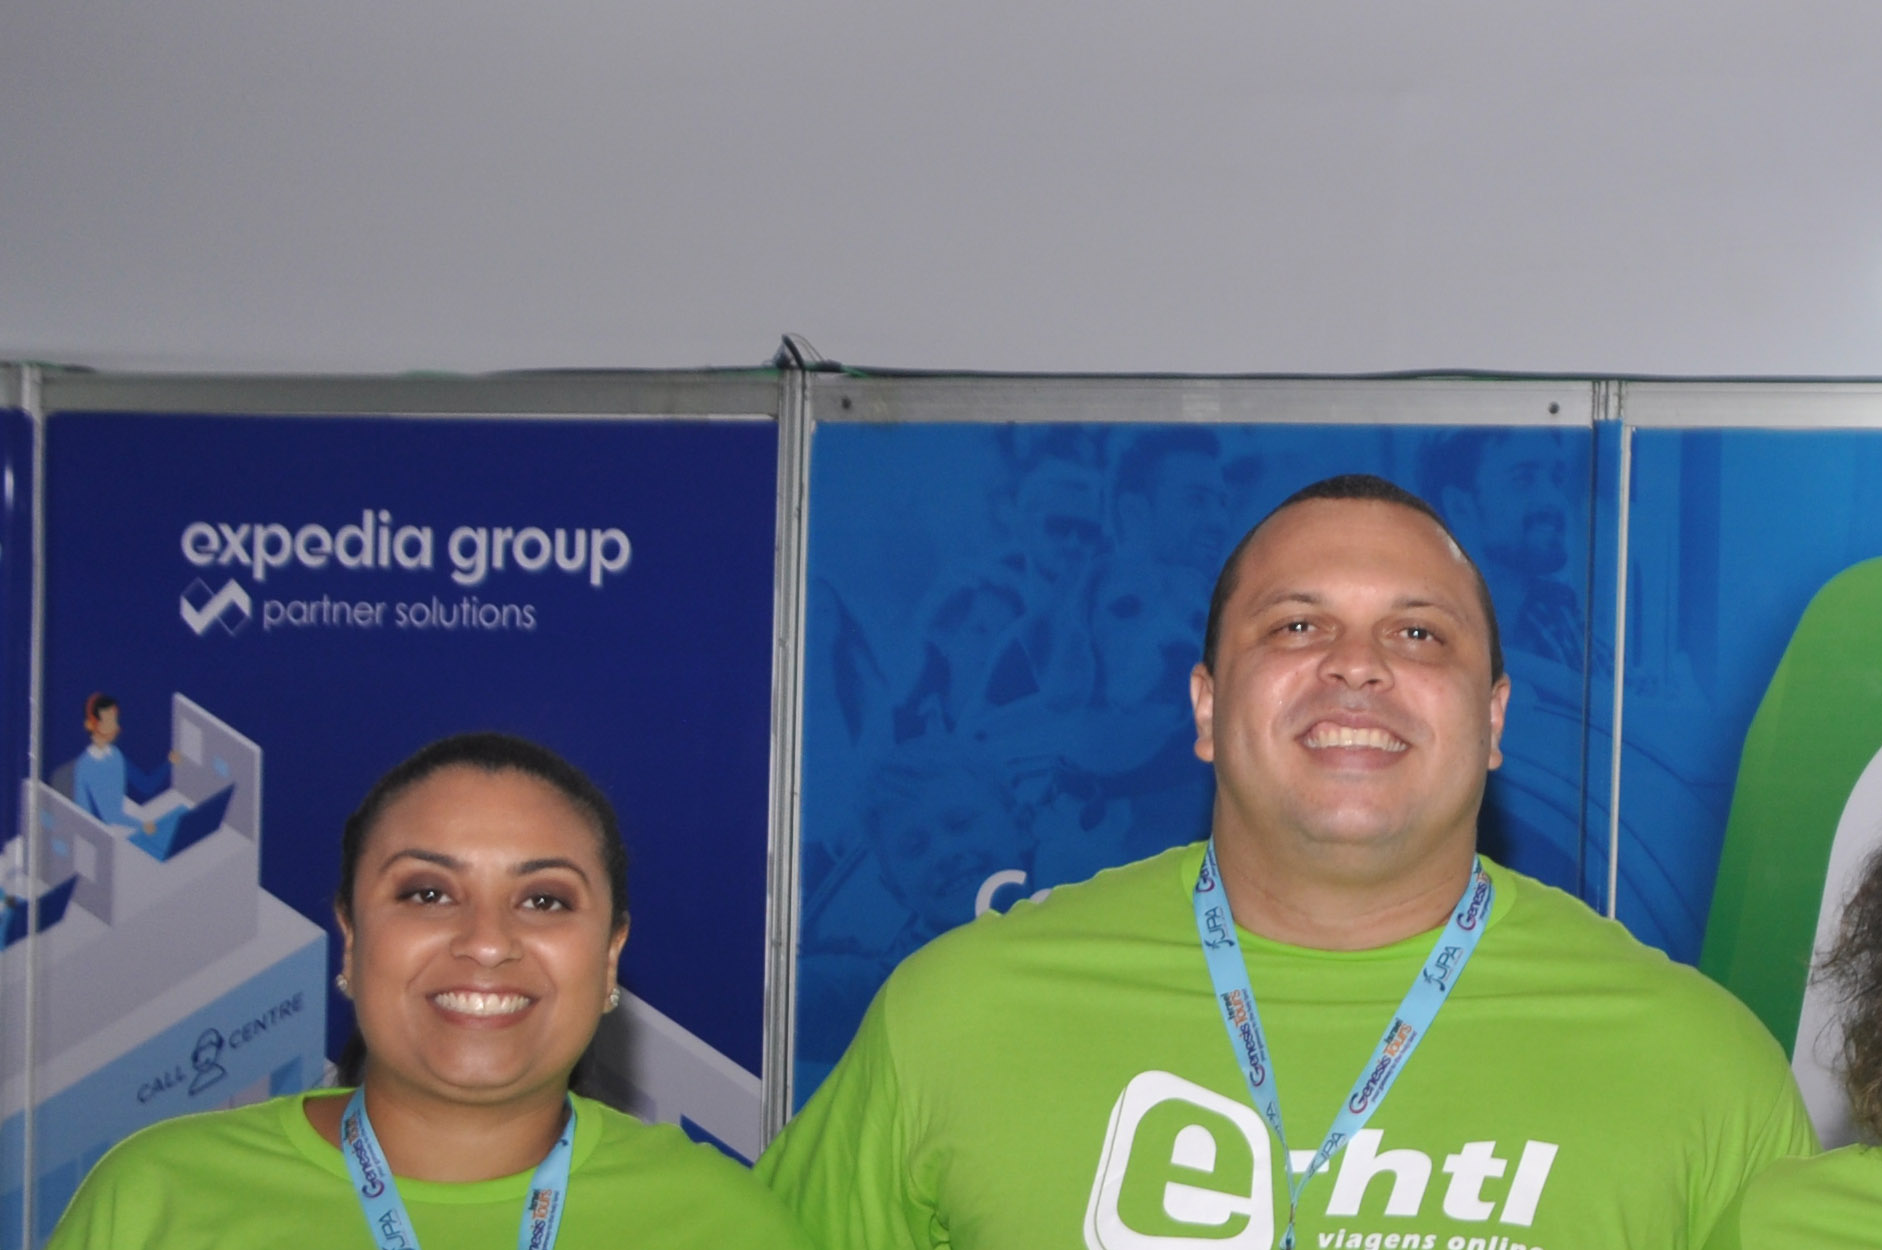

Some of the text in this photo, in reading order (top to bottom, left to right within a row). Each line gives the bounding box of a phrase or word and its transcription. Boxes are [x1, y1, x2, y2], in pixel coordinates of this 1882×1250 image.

[180, 509, 632, 586] expedia group
[262, 594, 538, 631] partner solutions
[137, 991, 304, 1103] CALL CENTRE
[1349, 1055, 1392, 1114] Genesis
